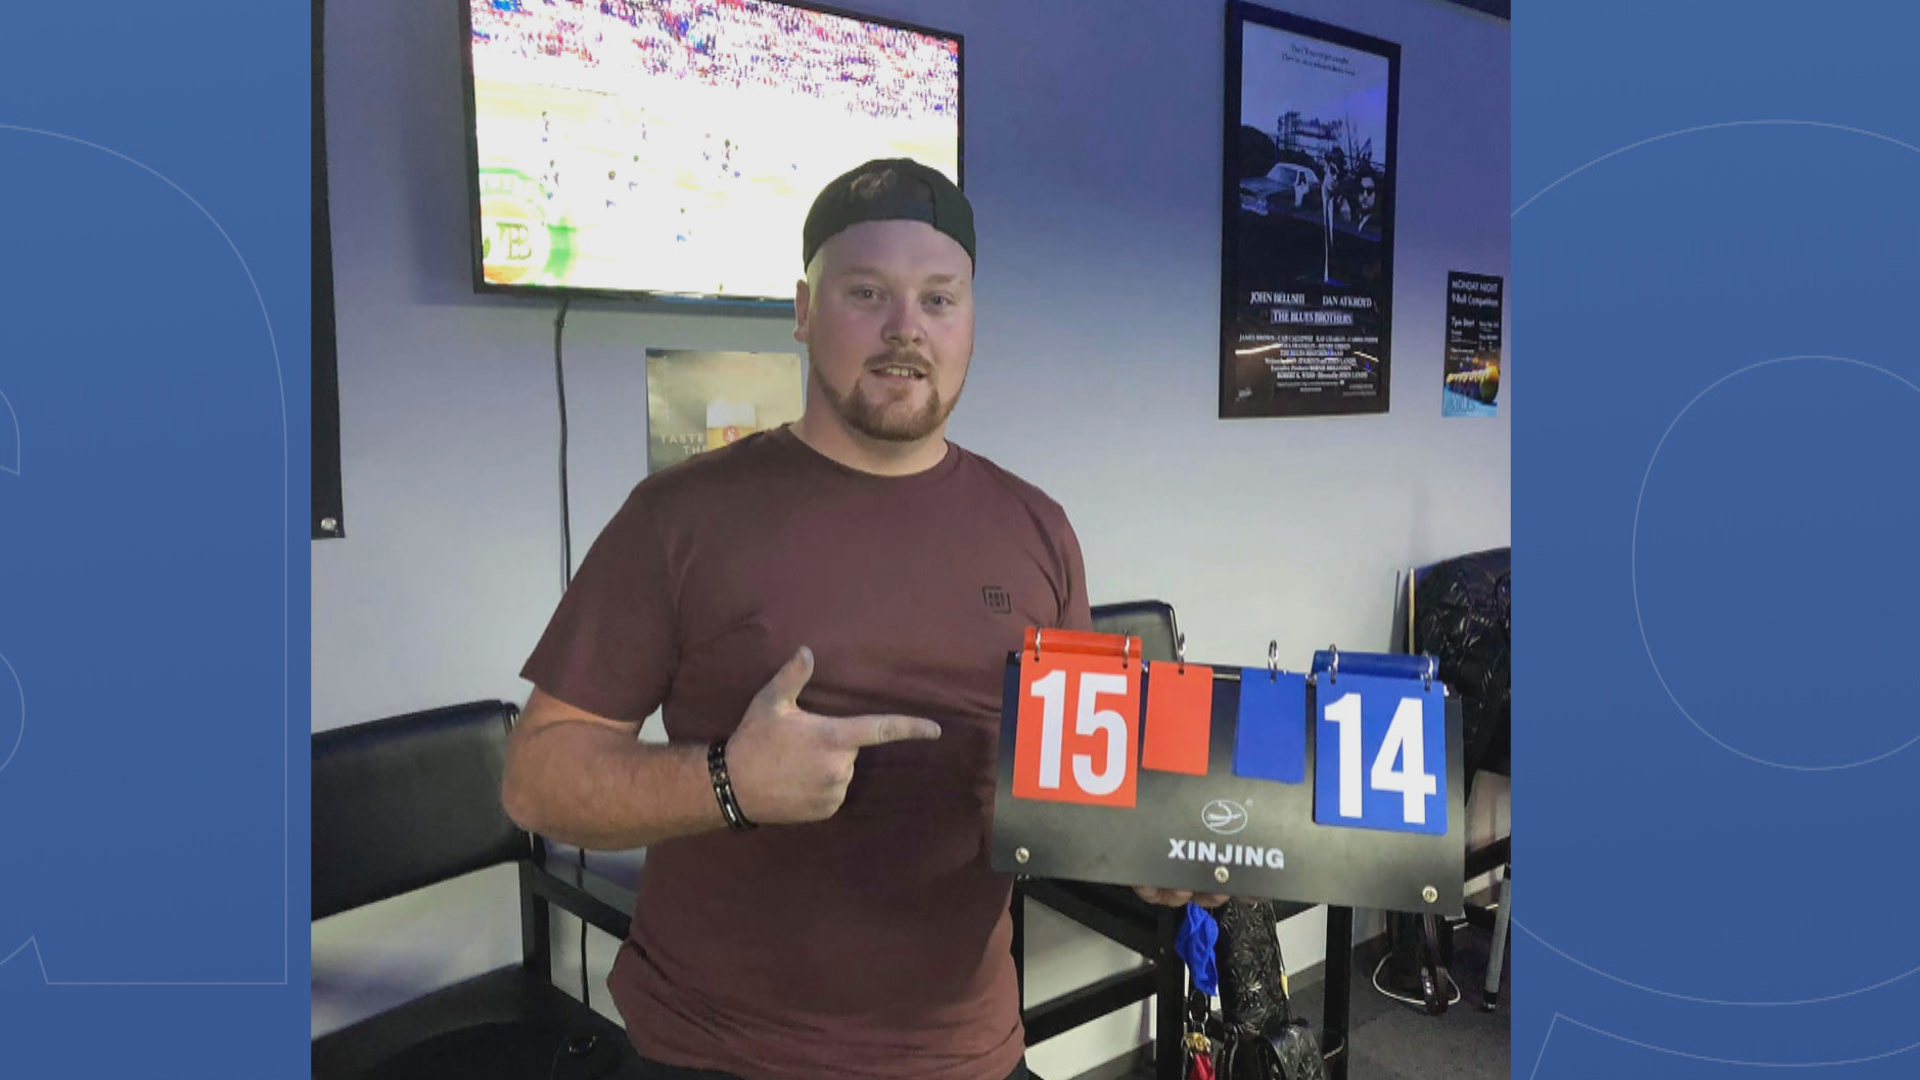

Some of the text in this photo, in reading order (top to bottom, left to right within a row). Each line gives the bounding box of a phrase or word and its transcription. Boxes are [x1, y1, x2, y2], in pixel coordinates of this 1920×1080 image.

[1452, 279, 1498, 293] MONDAY NIGHT
[1250, 291, 1272, 304] JOHN
[1322, 295, 1338, 306] DAN
[1273, 311, 1352, 325] THE BLUES BROTHERS
[660, 433, 705, 445] TASTE
[1030, 669, 1128, 796] 15
[1323, 692, 1438, 825] 14
[1167, 838, 1285, 869] XINJING
